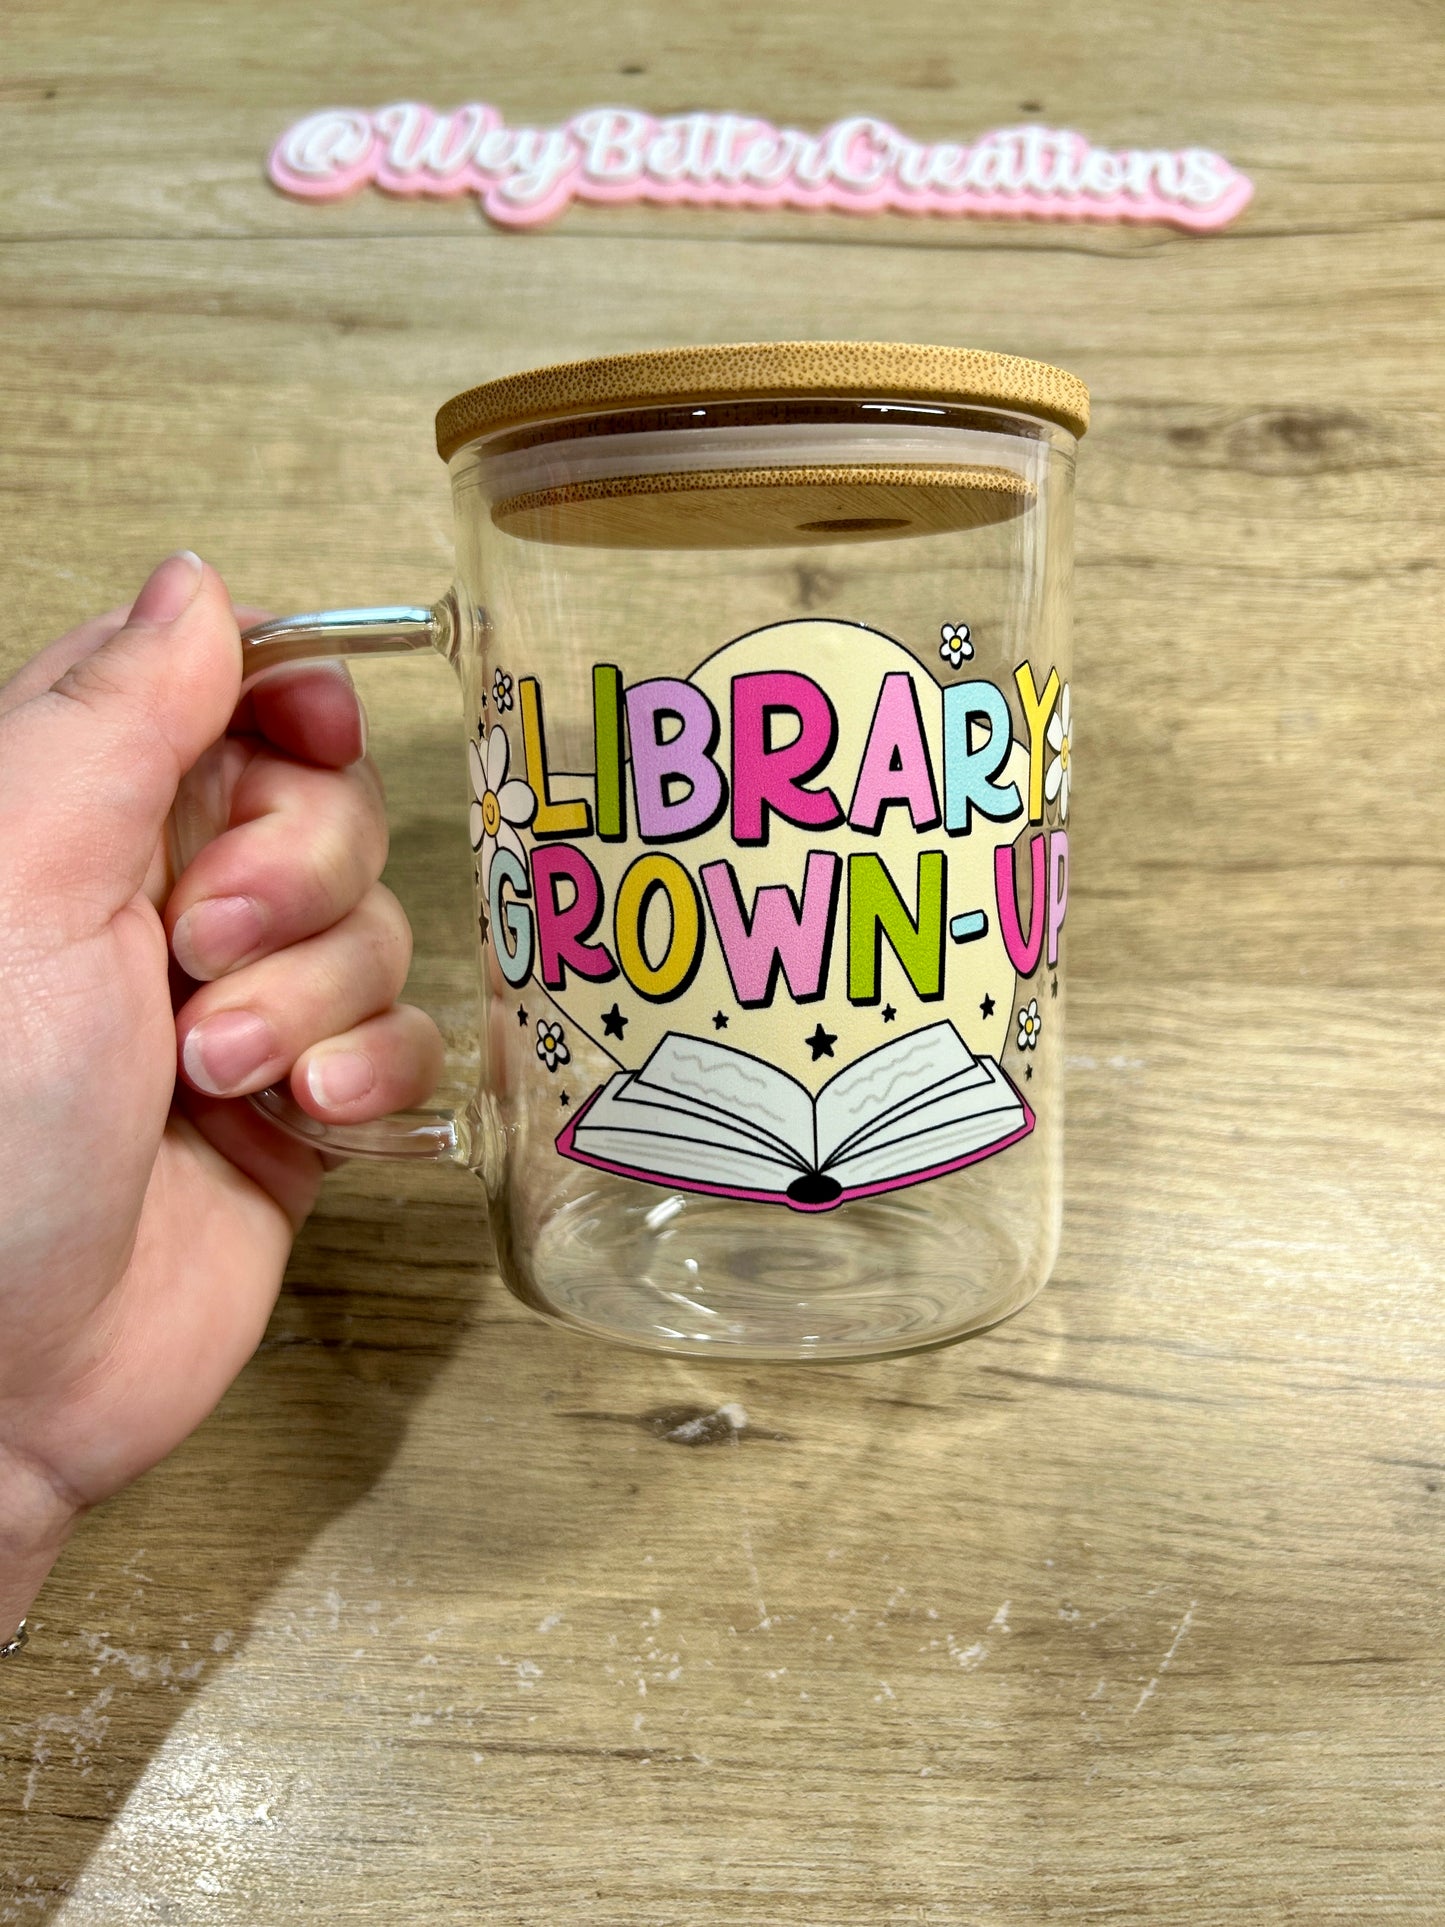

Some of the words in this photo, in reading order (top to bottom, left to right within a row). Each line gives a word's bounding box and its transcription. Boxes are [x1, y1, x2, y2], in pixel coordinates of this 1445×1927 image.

[281, 102, 1238, 206] @WeyBetterCreations
[518, 660, 1061, 846] LIBRARY
[490, 830, 1069, 1009] GROWN-UP
